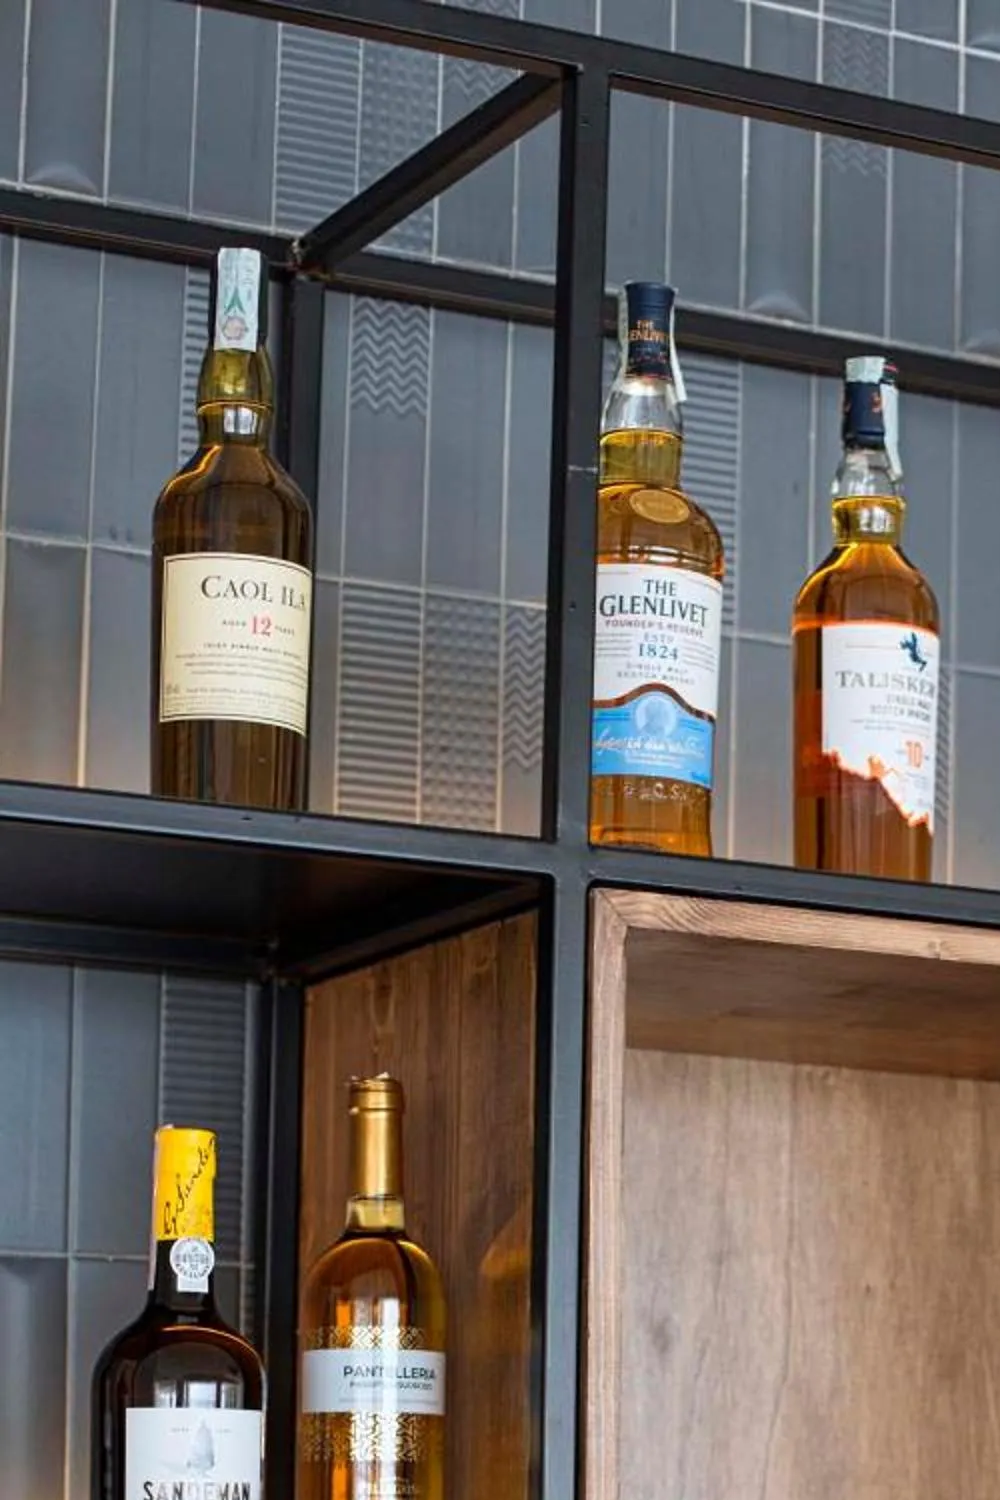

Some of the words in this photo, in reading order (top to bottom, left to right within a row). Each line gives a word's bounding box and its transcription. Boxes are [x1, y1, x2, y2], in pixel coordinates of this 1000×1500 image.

[201, 575, 273, 603] CAOL
[643, 579, 678, 597] THE
[599, 595, 709, 628] GLENLIVET
[250, 614, 273, 638] 12
[638, 643, 679, 661] 1824
[343, 1365, 437, 1381] PANTLLERIA
